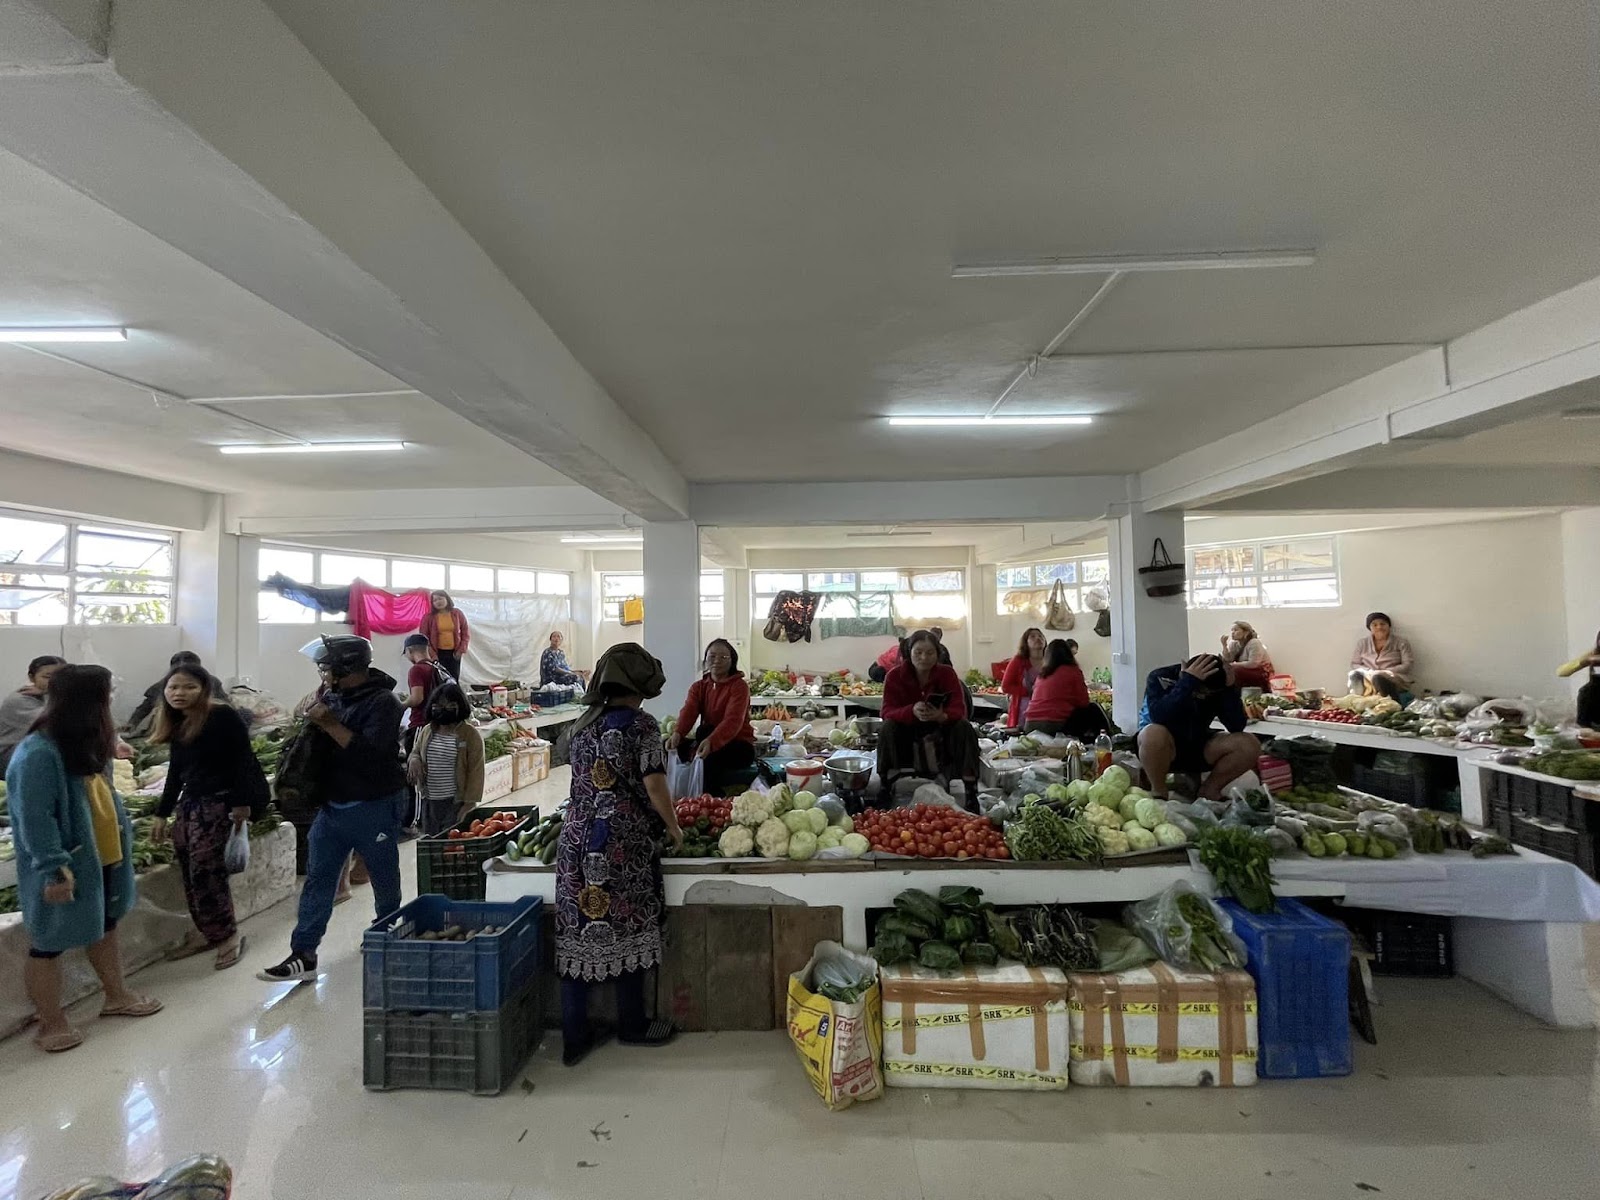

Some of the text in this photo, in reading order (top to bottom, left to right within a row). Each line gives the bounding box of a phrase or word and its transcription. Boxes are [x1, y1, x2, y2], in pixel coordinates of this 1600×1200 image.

[1193, 1003, 1211, 1012] SRK
[942, 1014, 961, 1024] SRK
[983, 1009, 1002, 1020] SRK
[1202, 1049, 1220, 1057] SRK
[1244, 1049, 1256, 1058] SR
[914, 1064, 932, 1073] SRK
[955, 1067, 974, 1076] SRK
[997, 1069, 1016, 1079] SRK
